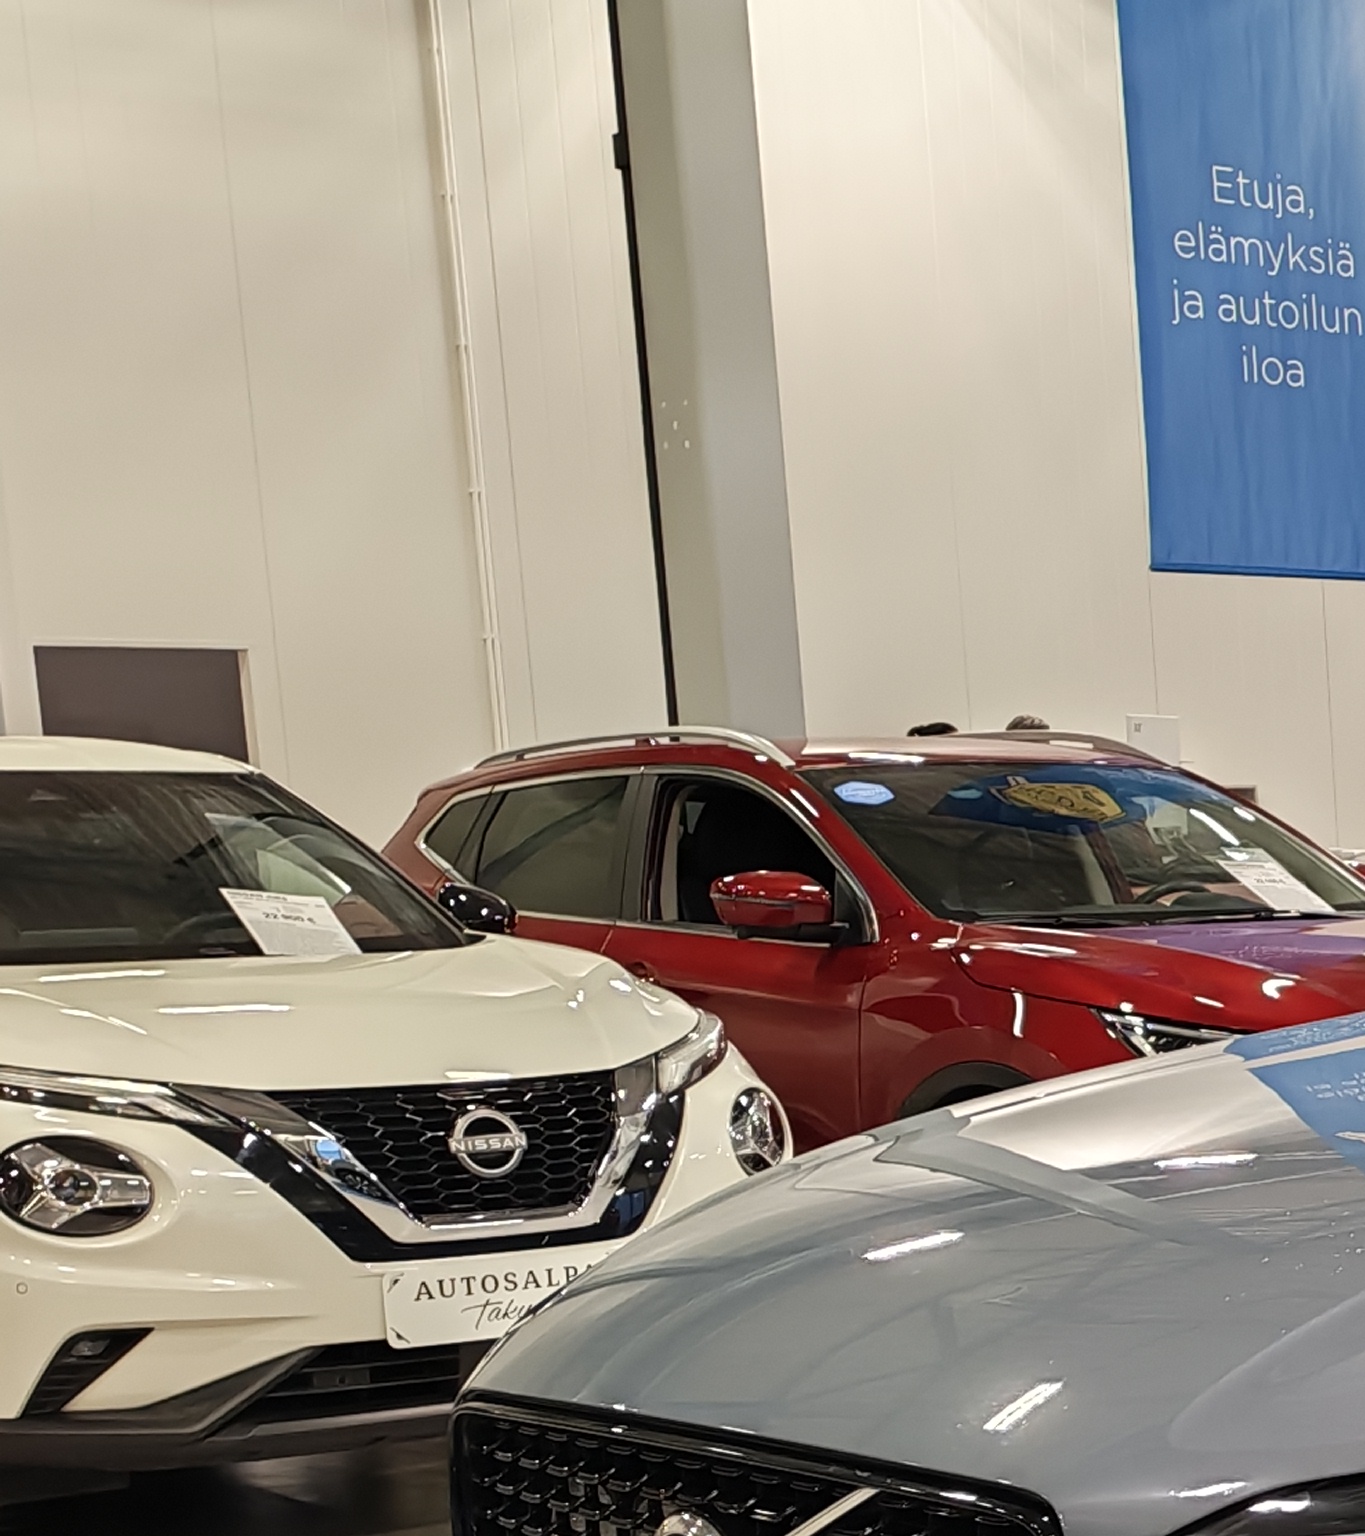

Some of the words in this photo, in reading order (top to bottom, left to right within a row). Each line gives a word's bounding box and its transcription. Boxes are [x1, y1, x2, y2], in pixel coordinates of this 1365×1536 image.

[1211, 165, 1315, 220] Etuja,
[1173, 220, 1355, 278] elämyksiä
[1171, 278, 1205, 325] ja
[1217, 290, 1363, 337] autoilun
[1241, 345, 1306, 388] iloa
[451, 1136, 527, 1151] NISSAN
[414, 1264, 593, 1302] AUTOSALP
[461, 1298, 533, 1331] Taku
